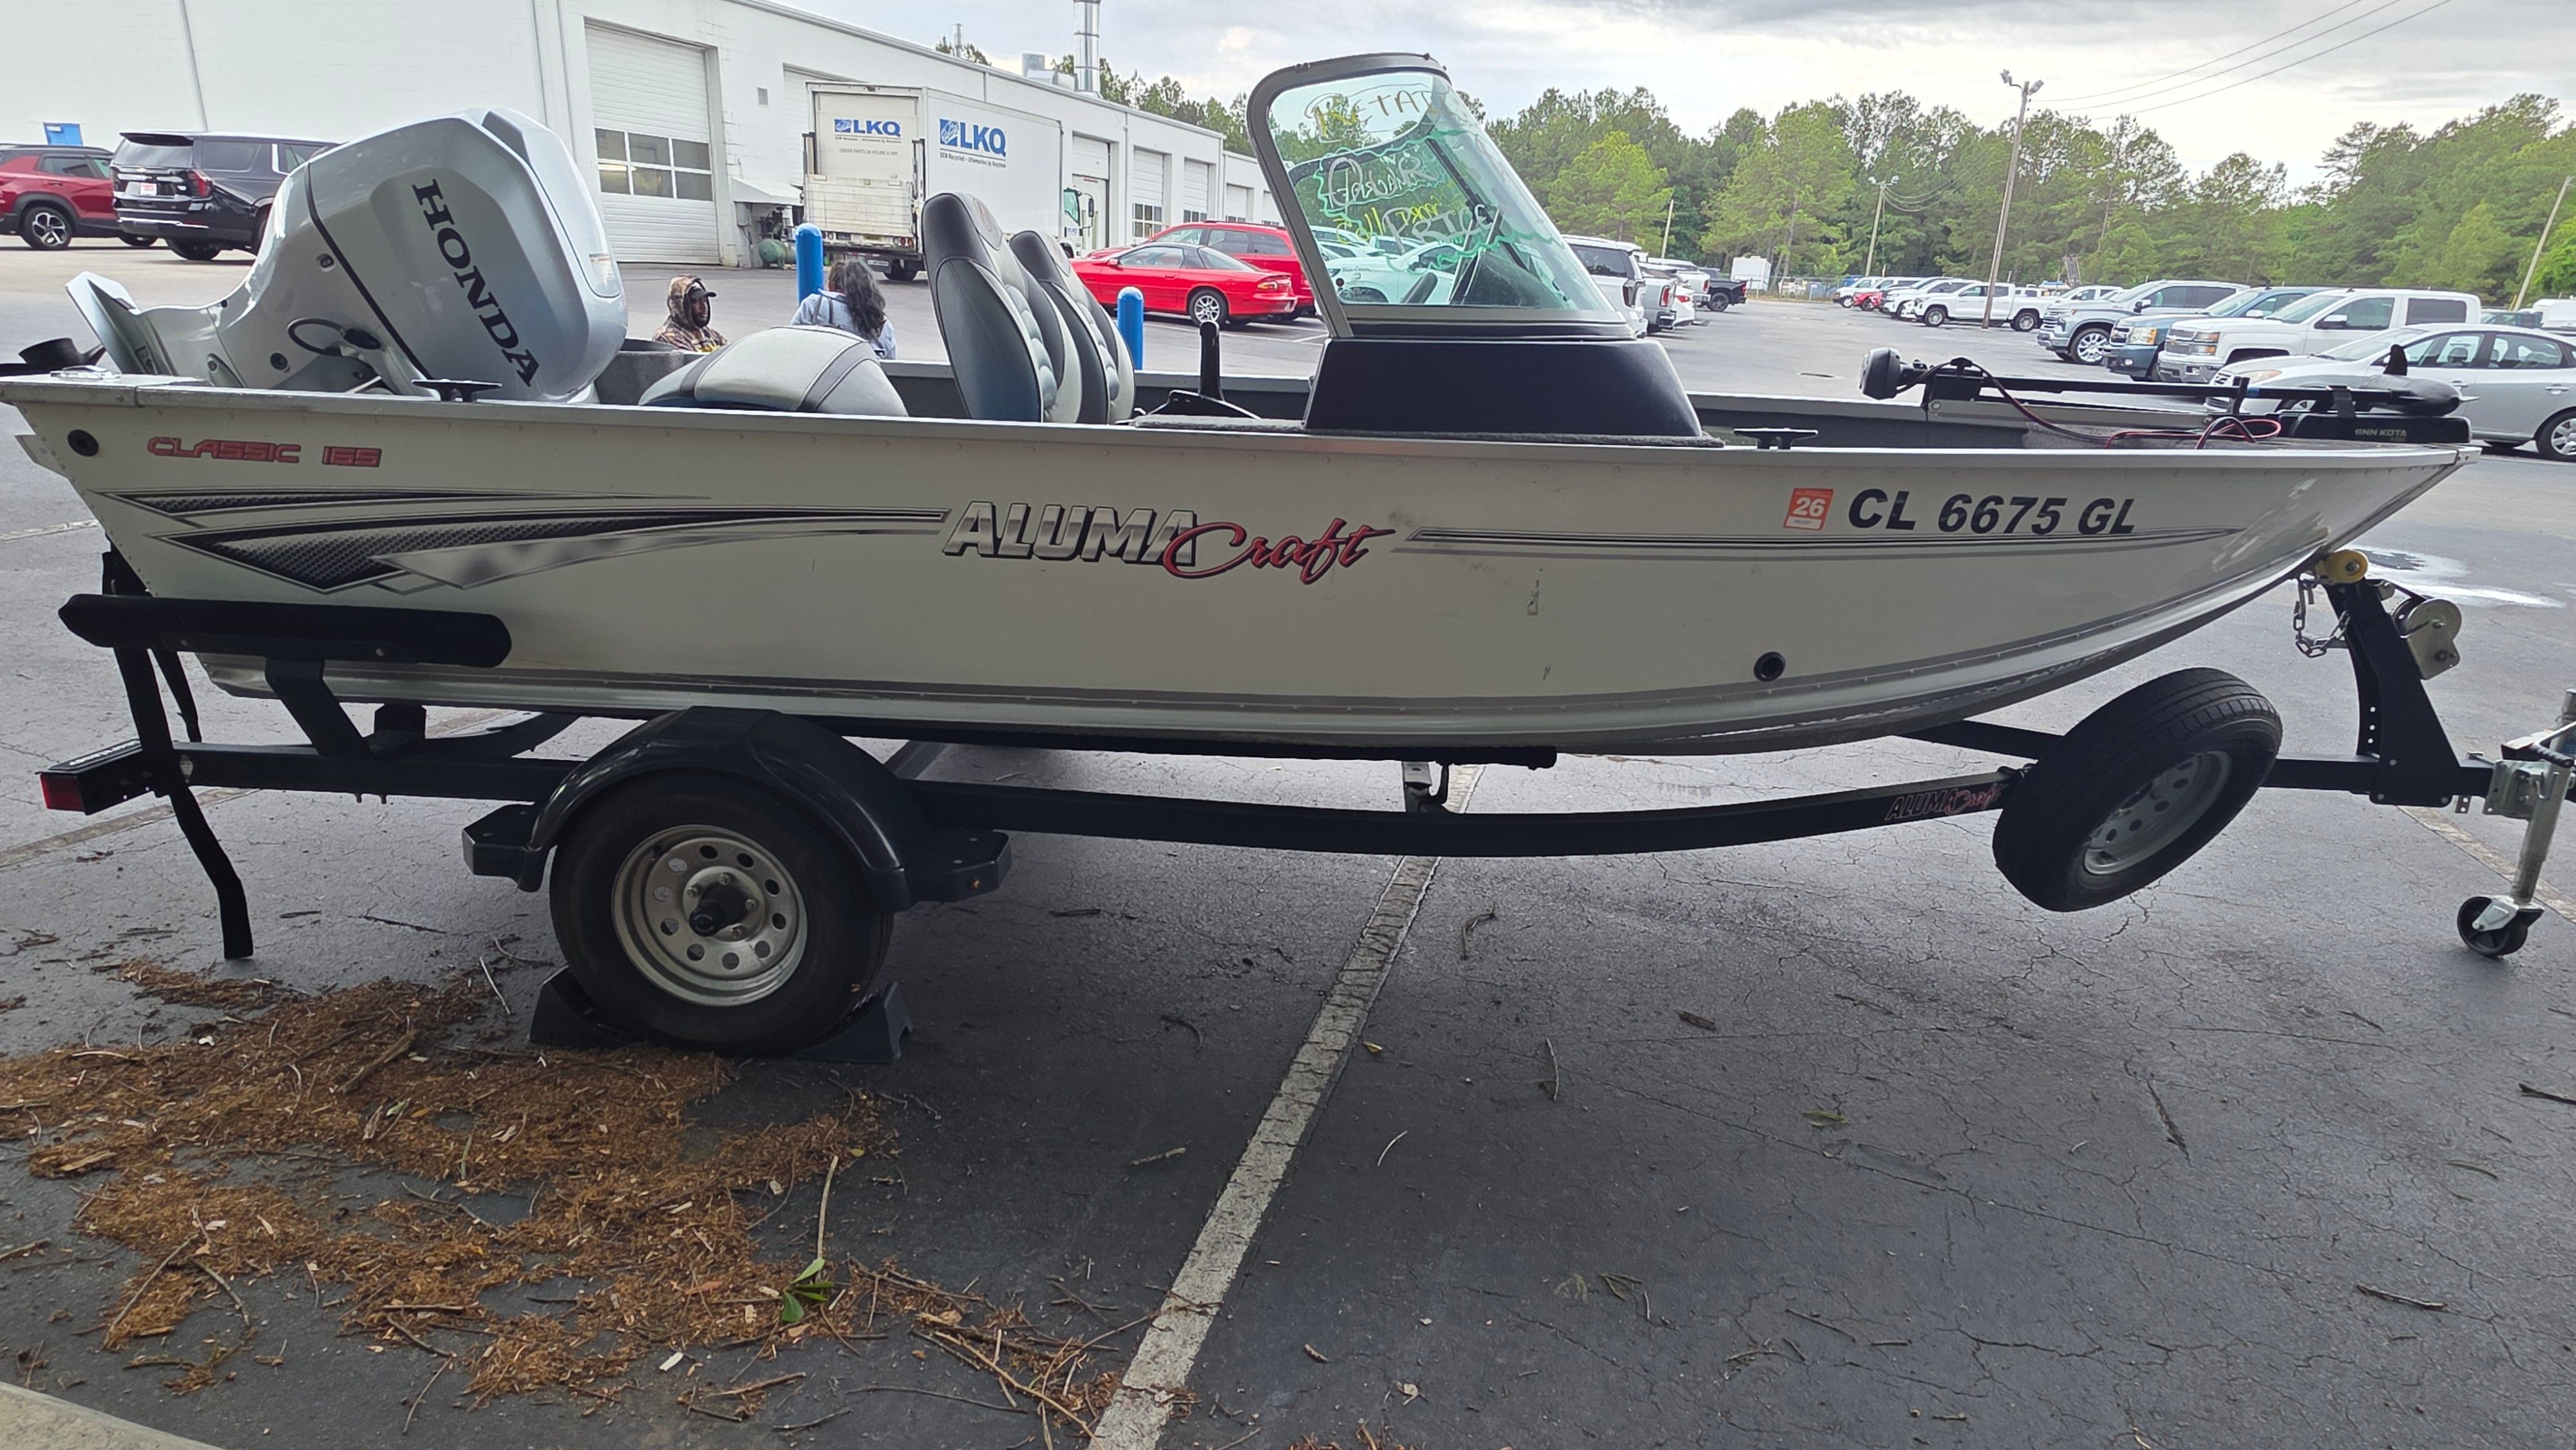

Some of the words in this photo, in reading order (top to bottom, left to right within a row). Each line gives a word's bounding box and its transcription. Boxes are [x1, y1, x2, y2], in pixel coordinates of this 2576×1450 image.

[853, 119, 901, 137] LKQ
[960, 122, 1006, 157] LKQ
[413, 178, 540, 387] HONDA
[147, 436, 301, 464] CLASSIC
[321, 446, 383, 468] 165
[1792, 496, 1826, 518] 26
[1848, 488, 1917, 531] CL
[1937, 493, 2067, 535] 6675
[2077, 498, 2136, 534] GL
